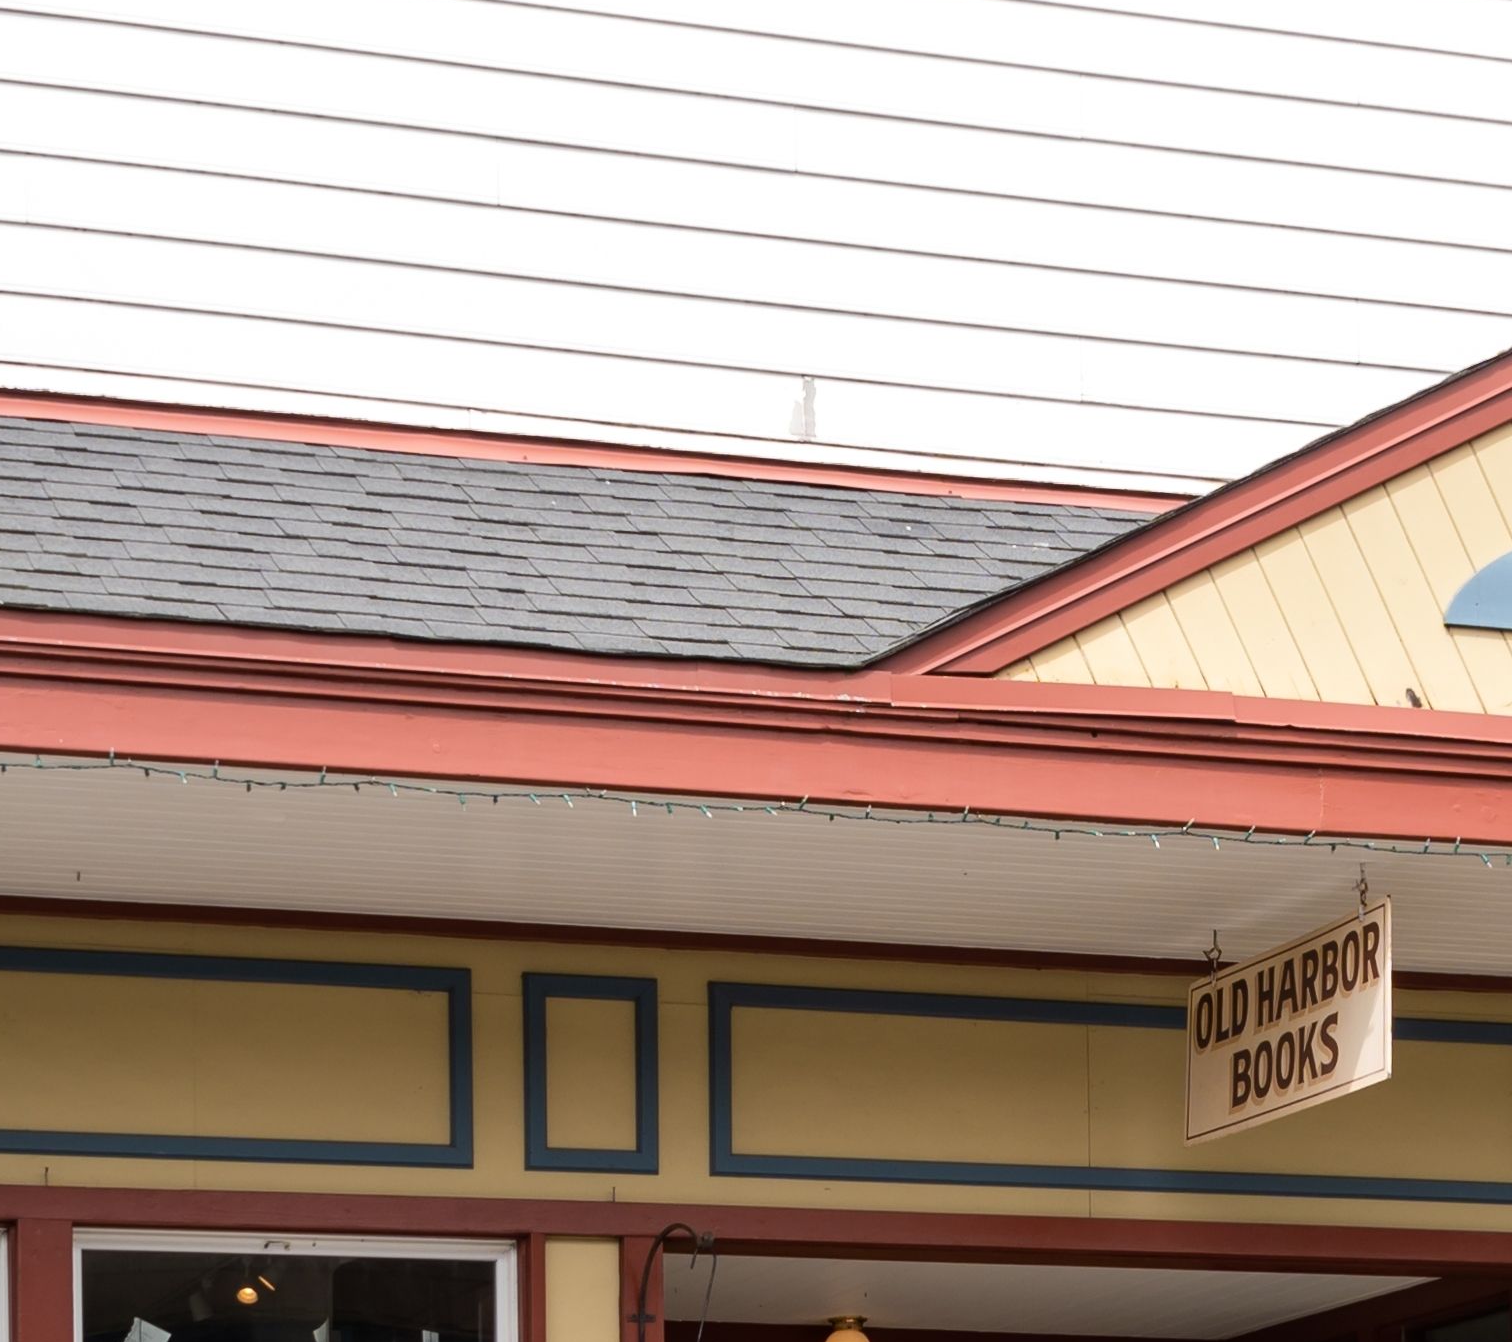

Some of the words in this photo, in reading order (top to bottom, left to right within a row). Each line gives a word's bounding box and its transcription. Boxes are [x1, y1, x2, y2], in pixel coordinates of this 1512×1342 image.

[1195, 978, 1249, 1050] OLD
[1257, 921, 1380, 1028] HARBOR
[1231, 1012, 1339, 1109] BOOKS
